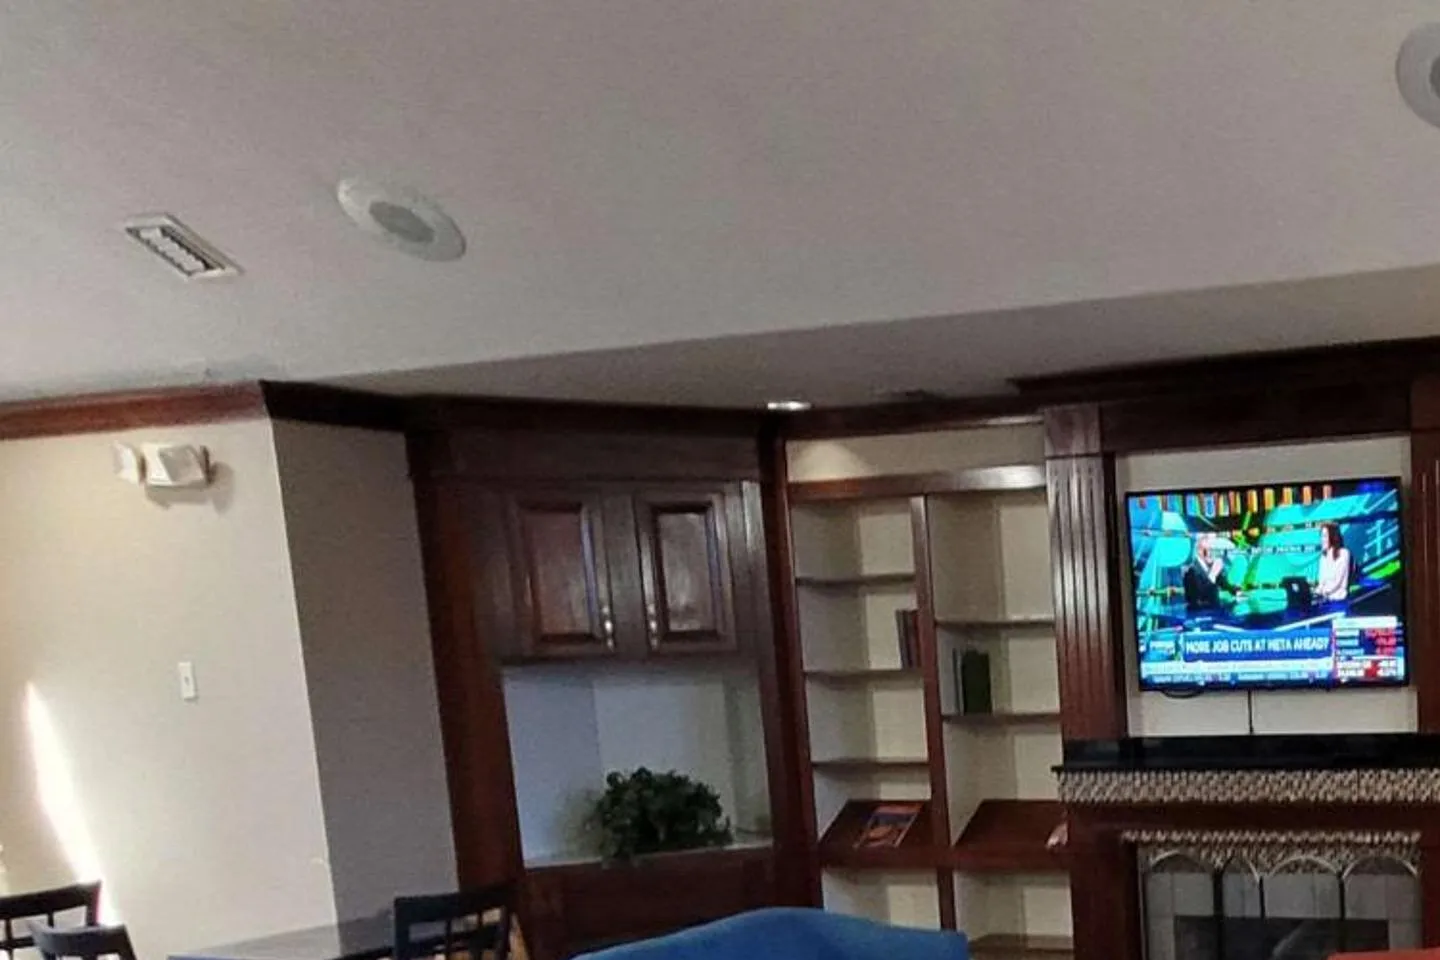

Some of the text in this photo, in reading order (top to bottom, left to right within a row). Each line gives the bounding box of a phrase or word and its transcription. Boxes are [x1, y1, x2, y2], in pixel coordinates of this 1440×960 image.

[1186, 641, 1210, 654] MORE
[1212, 639, 1229, 653] JOB
[1230, 639, 1252, 652] CUTS
[1255, 639, 1266, 651] AT
[1268, 638, 1291, 651] META
